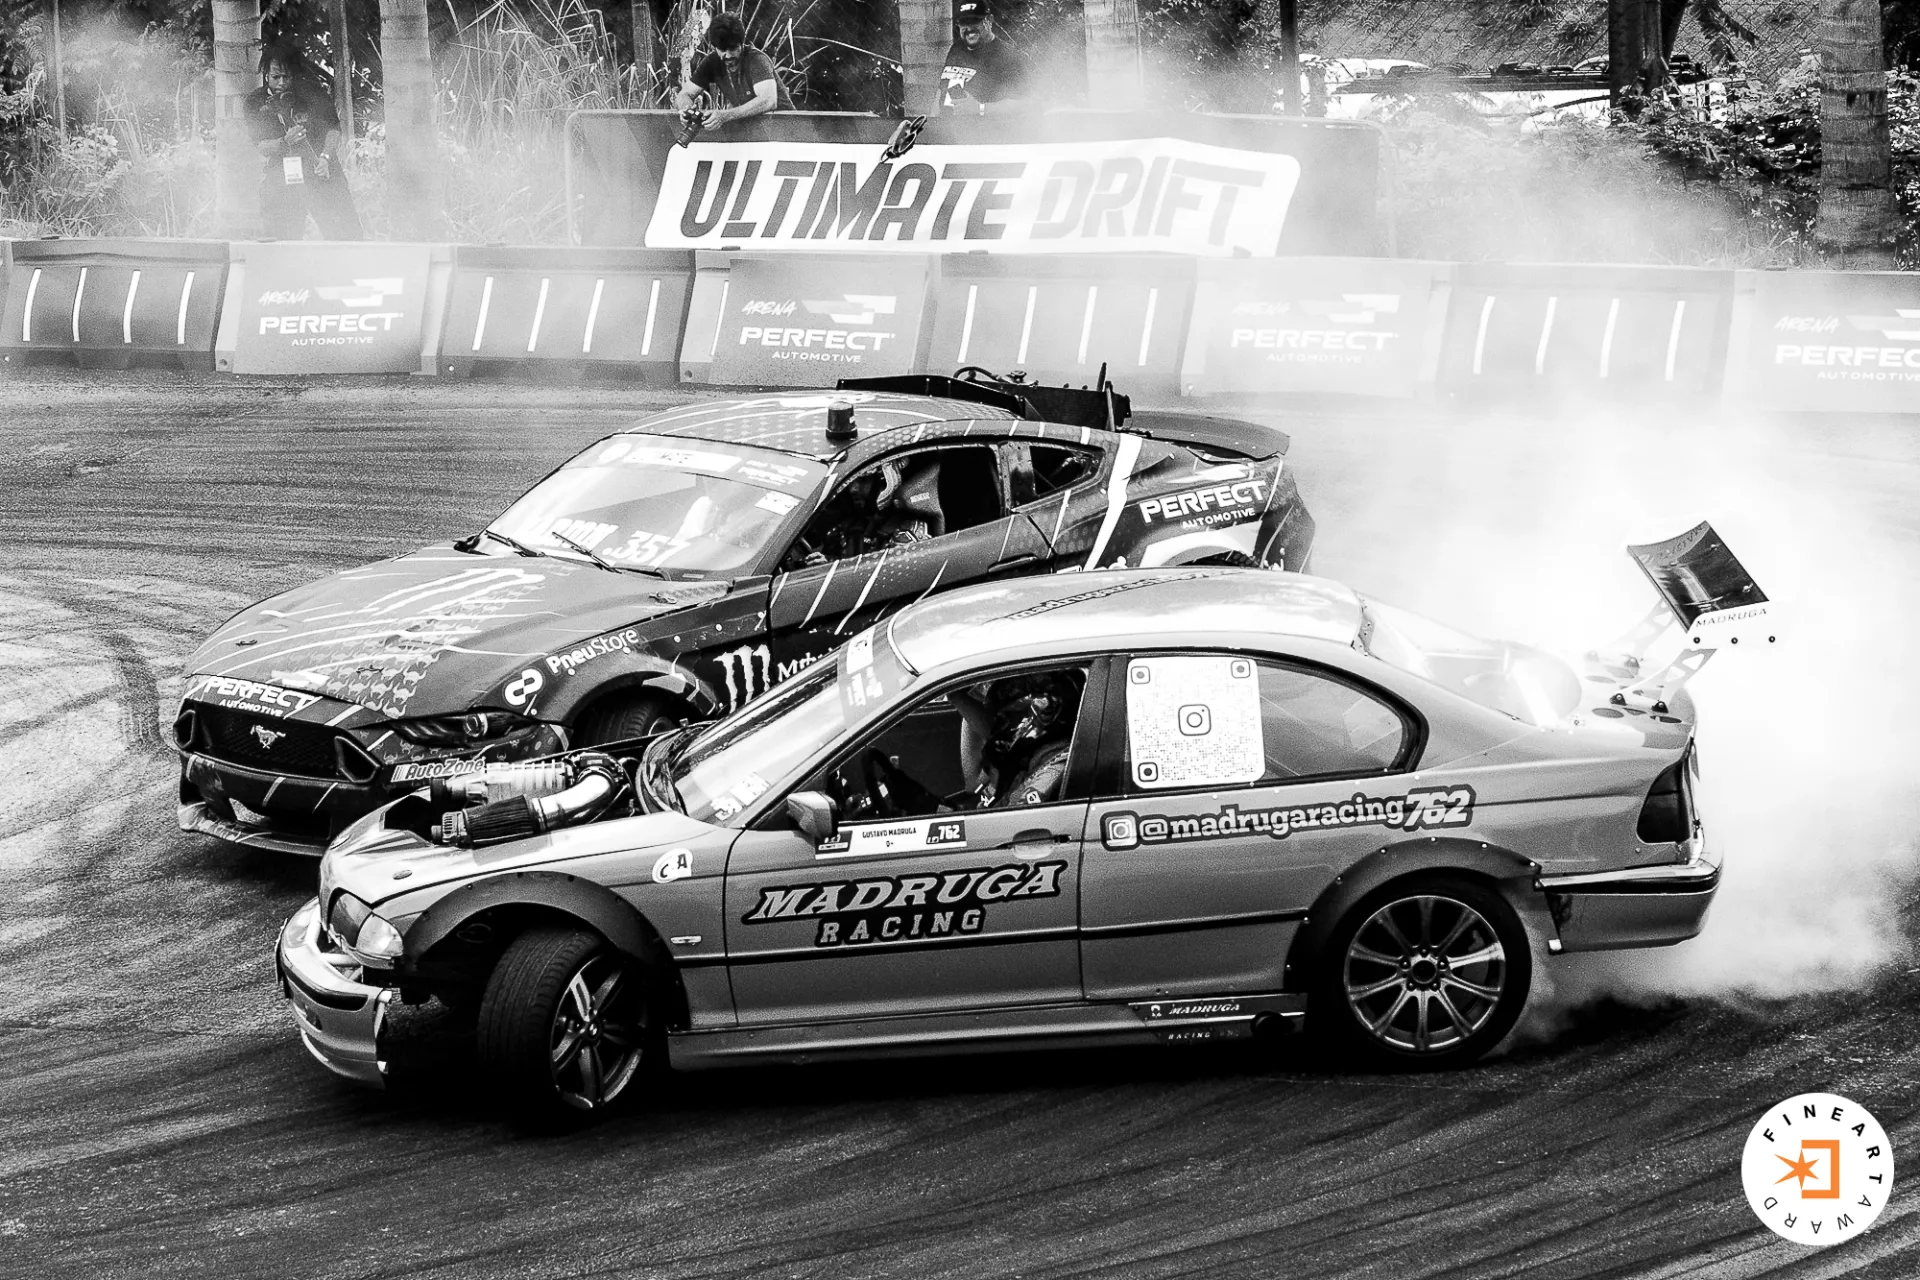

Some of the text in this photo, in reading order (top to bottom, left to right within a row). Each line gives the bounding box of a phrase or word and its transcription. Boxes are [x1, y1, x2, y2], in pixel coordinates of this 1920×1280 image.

[679, 155, 1268, 247] ULTIMATE DRIFT
[259, 287, 310, 305] ARENA
[742, 300, 799, 318] ARENA
[259, 312, 399, 336] PERFECT
[1773, 315, 1841, 335] ARENA
[291, 335, 374, 347] AUTOMOTIVE
[739, 326, 893, 352] PERFECT
[1231, 328, 1397, 351] PERFECT
[772, 351, 861, 363] AUTOMOTIVE
[1266, 352, 1363, 364] AUTOMOTIVE
[1140, 480, 1267, 524] PERFECT
[1182, 507, 1256, 529] AUTOMOTIVE
[1695, 608, 1768, 628] MADRUGA
[545, 627, 640, 675] PneuStore
[205, 676, 322, 712] PERFECT
[218, 699, 284, 717] AUTOMOTIVE
[405, 757, 485, 780] AutoZone
[862, 827, 917, 839] GUSTAVO MADRUGA
[938, 824, 961, 840] 762
[748, 864, 1064, 920] MADRUGA
[820, 910, 981, 943] RACING
[1168, 1003, 1241, 1015] MADRUGA
